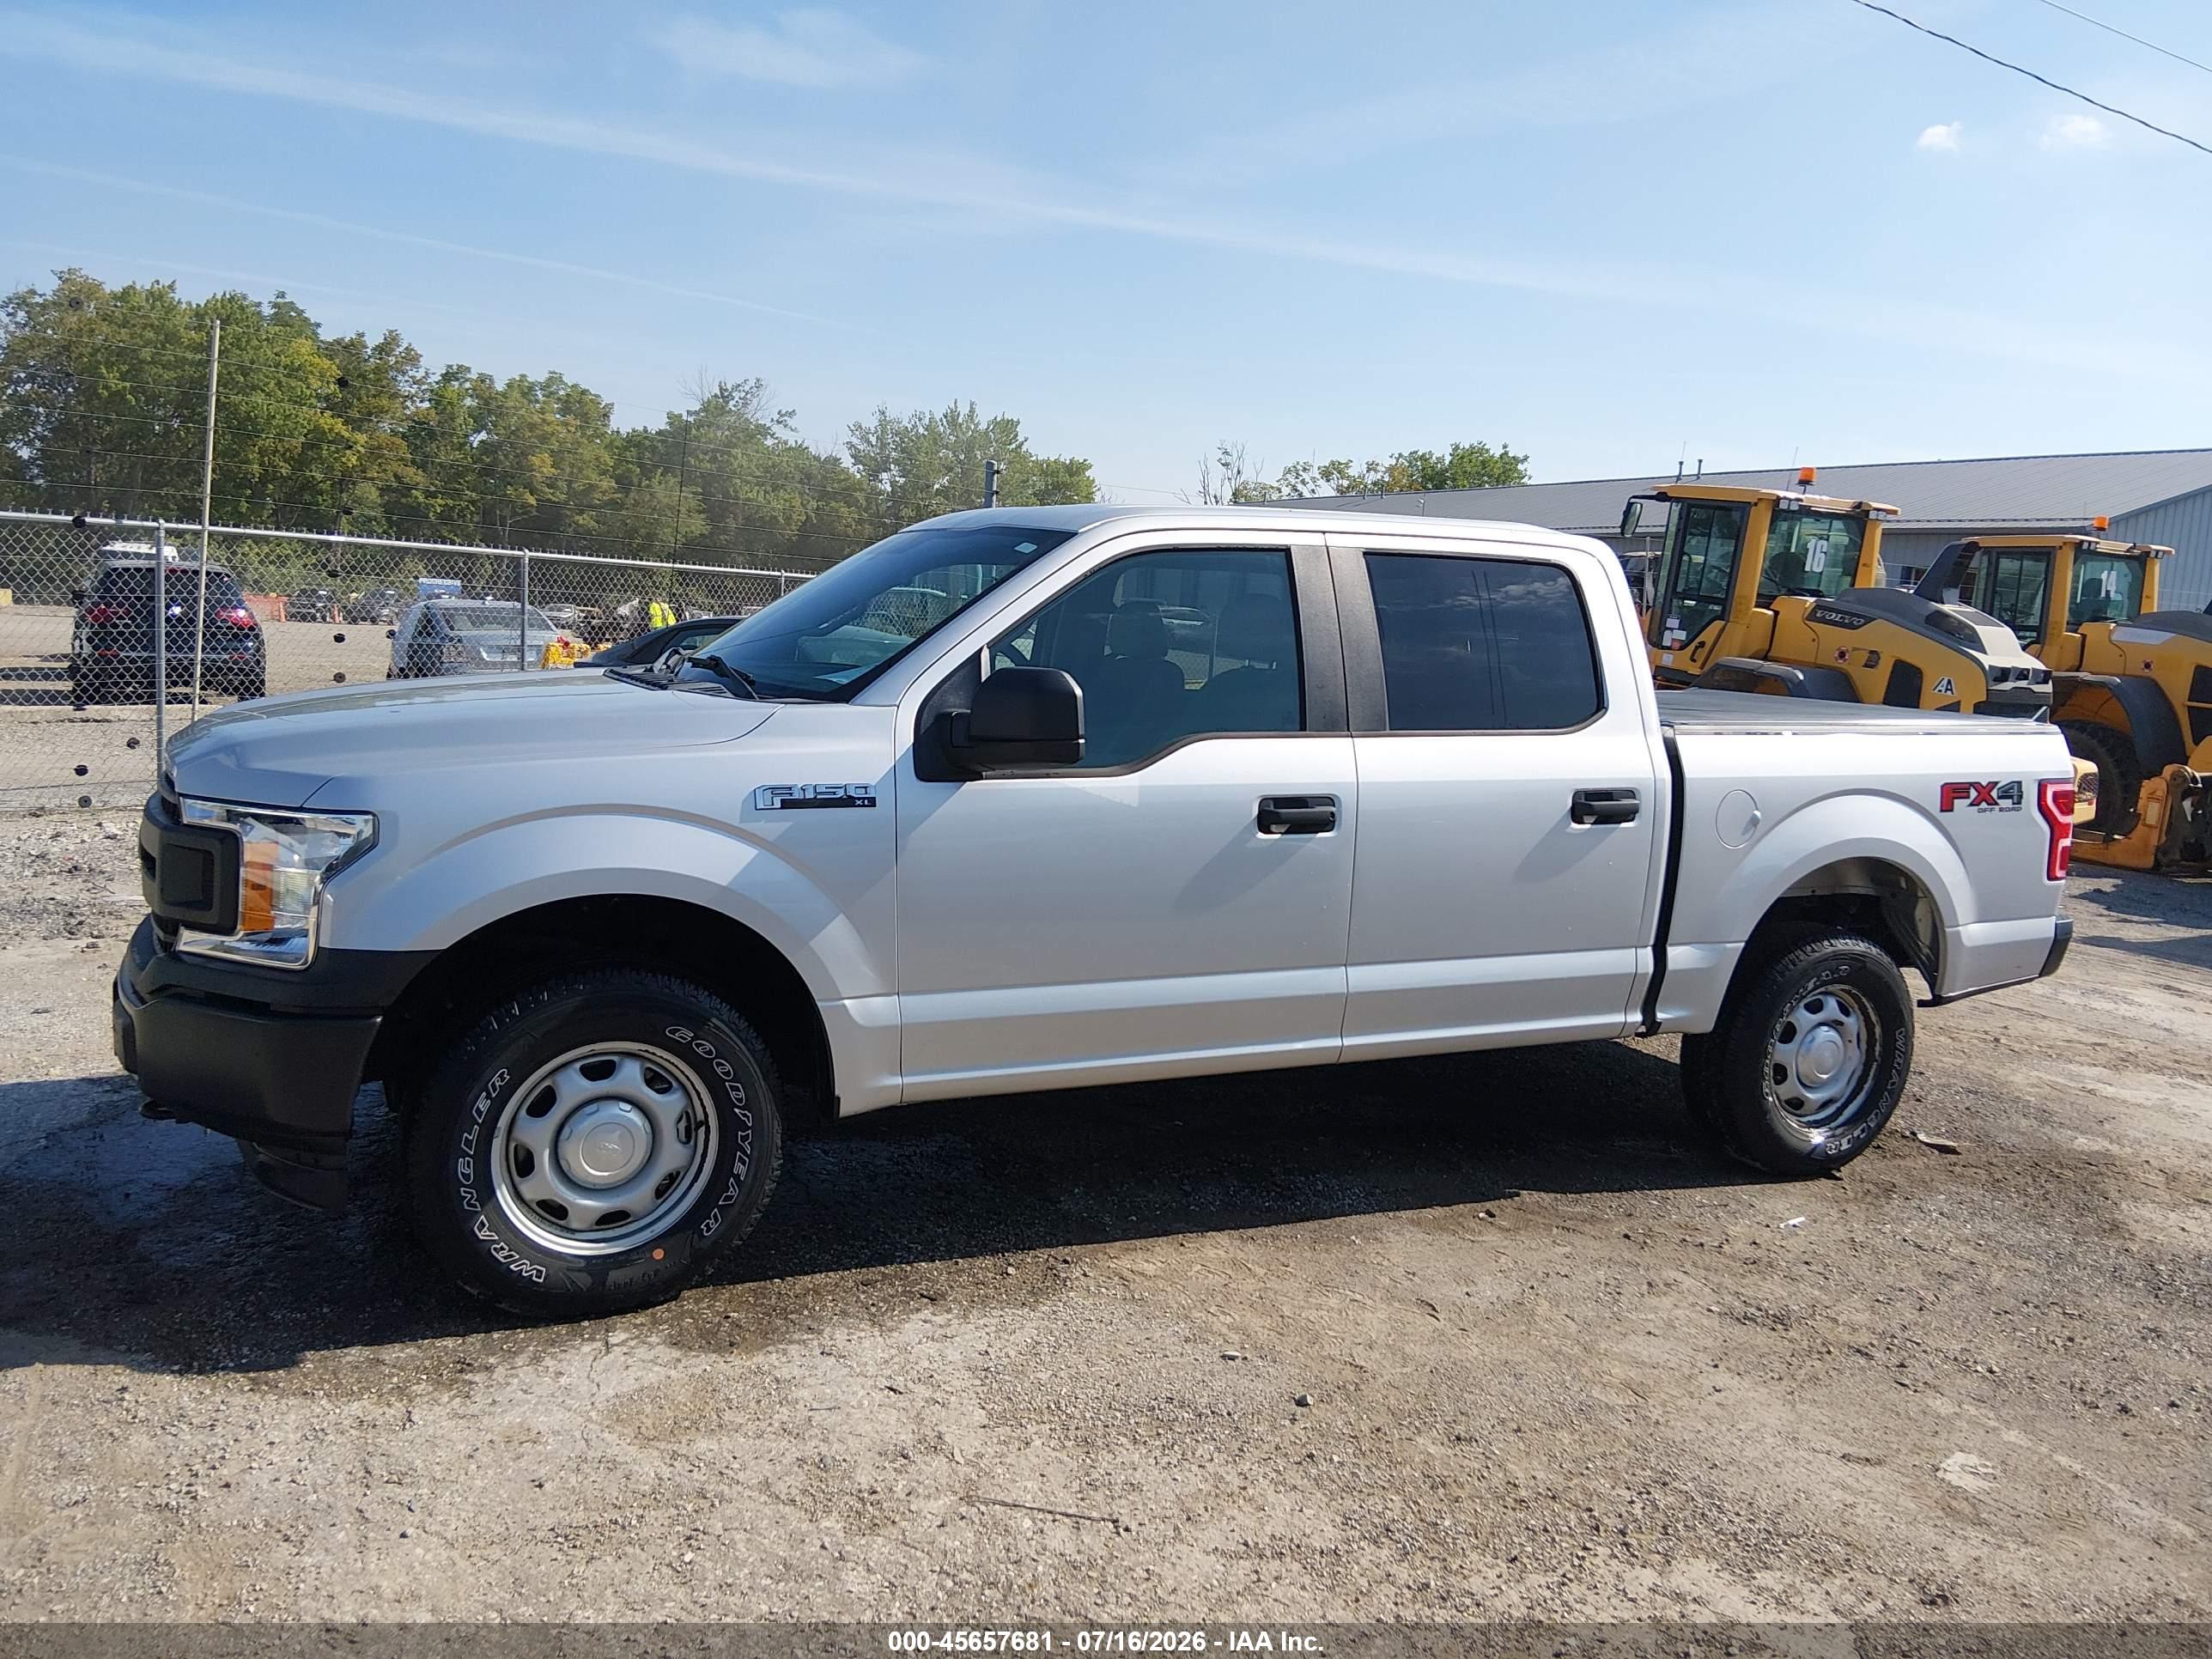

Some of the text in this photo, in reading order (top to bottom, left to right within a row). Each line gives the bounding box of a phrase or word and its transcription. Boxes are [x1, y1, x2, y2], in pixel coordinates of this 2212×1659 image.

[1805, 537, 1827, 573] 16
[2100, 570, 2117, 599] 14
[1815, 610, 1866, 626] VOLVO
[1940, 780, 2024, 812] FX4
[665, 1025, 753, 1237] GOODYEAR
[458, 1067, 546, 1283] WRANGLER
